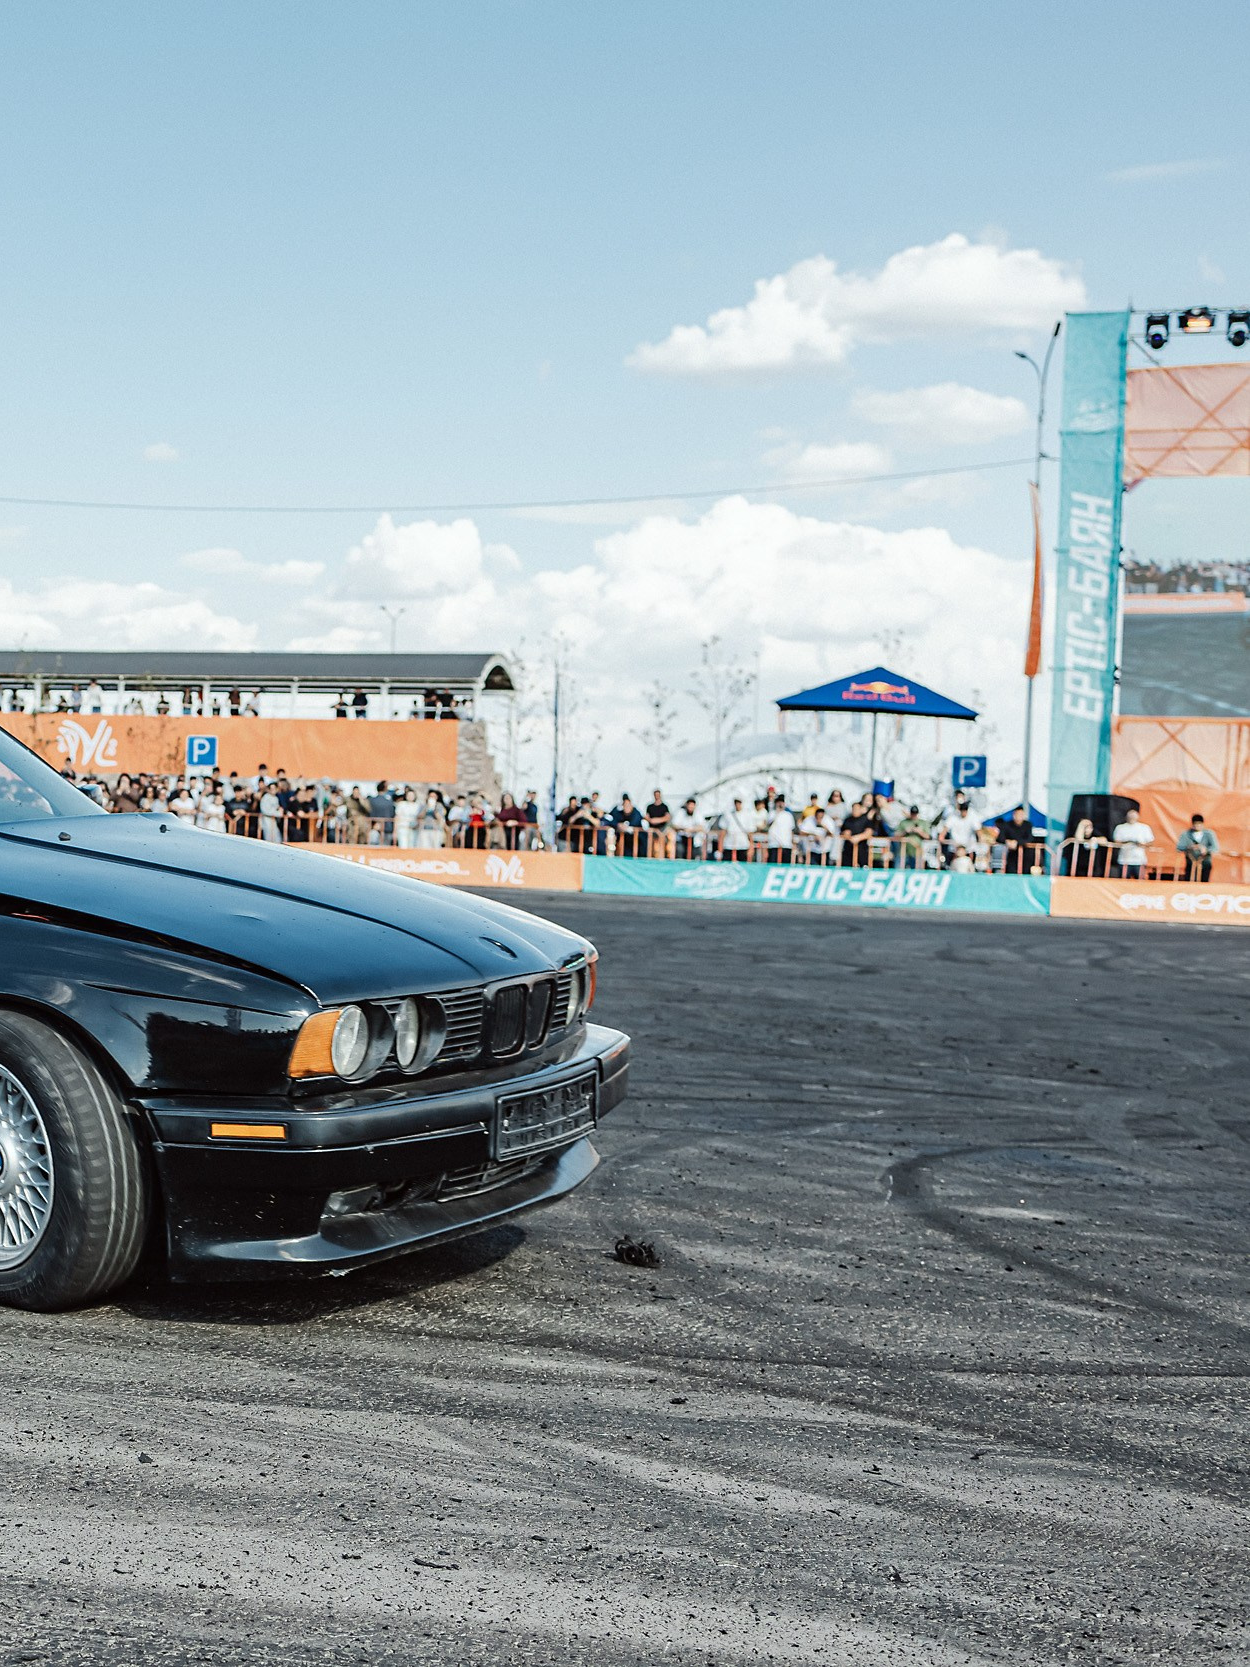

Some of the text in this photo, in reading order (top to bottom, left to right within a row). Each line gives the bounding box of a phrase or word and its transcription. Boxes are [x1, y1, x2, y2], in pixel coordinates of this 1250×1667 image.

[1063, 492, 1112, 721] ЕРТІС-БАЯН
[193, 738, 211, 763] P
[958, 757, 980, 785] P
[761, 866, 951, 906] ЕРТІС-БАЯН
